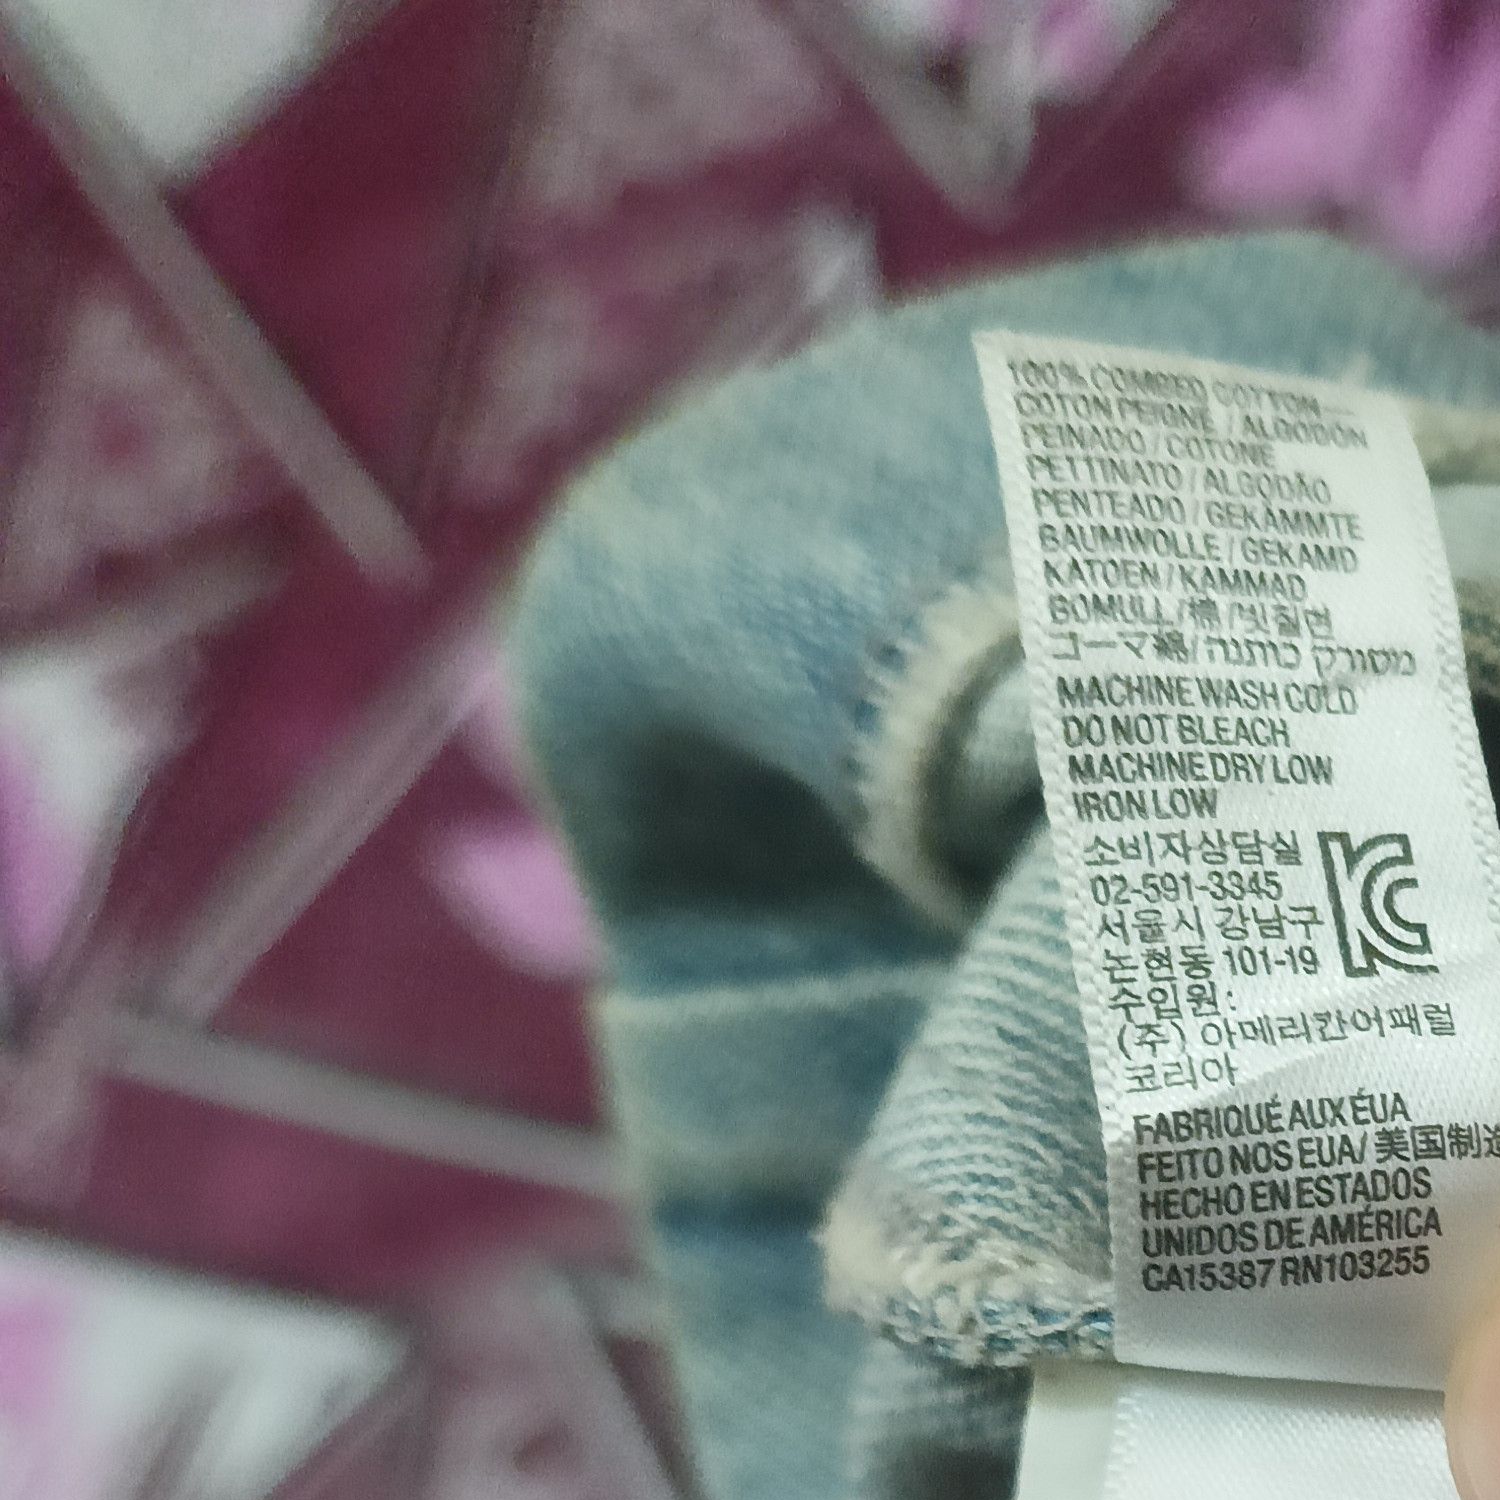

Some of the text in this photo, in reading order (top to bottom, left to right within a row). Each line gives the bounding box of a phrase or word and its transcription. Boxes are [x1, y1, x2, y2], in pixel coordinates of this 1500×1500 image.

[1166, 433, 1276, 468] COTONE
[1025, 454, 1183, 491] PETTINATO
[1032, 489, 1185, 524] PENTEADO
[1039, 523, 1221, 561] BAUMWOLLE
[1241, 536, 1359, 573] GEKAMD
[1043, 557, 1161, 590] KATOEN
[1178, 564, 1308, 603] KAMMAD
[1056, 673, 1358, 715] MACHINE WASH COLD
[1061, 714, 1291, 748] DO NOT BLEACH
[1068, 752, 1333, 786] MACHINE DRY LOW
[1072, 788, 1218, 822] IRON LOW
[1084, 829, 1304, 868] 소비자상담실
[1090, 870, 1284, 906] 02-591-3345
[1097, 903, 1325, 946] 서울시 강남구
[1102, 944, 1319, 984] 논현동 101-19
[1200, 1002, 1457, 1050] 아메리칸어패럴
[1125, 1052, 1239, 1094] 코리아
[1133, 1087, 1412, 1146] FABRIQUÉ AUX ÉUA
[1137, 1147, 1225, 1184] FEITO
[1230, 1139, 1294, 1177] NOS
[1139, 1165, 1433, 1222] HECHO EN ESTADOS
[1142, 1205, 1443, 1258] UNIDOS DE AMÉRICA
[1141, 1244, 1431, 1293] CA15387 RN103255
